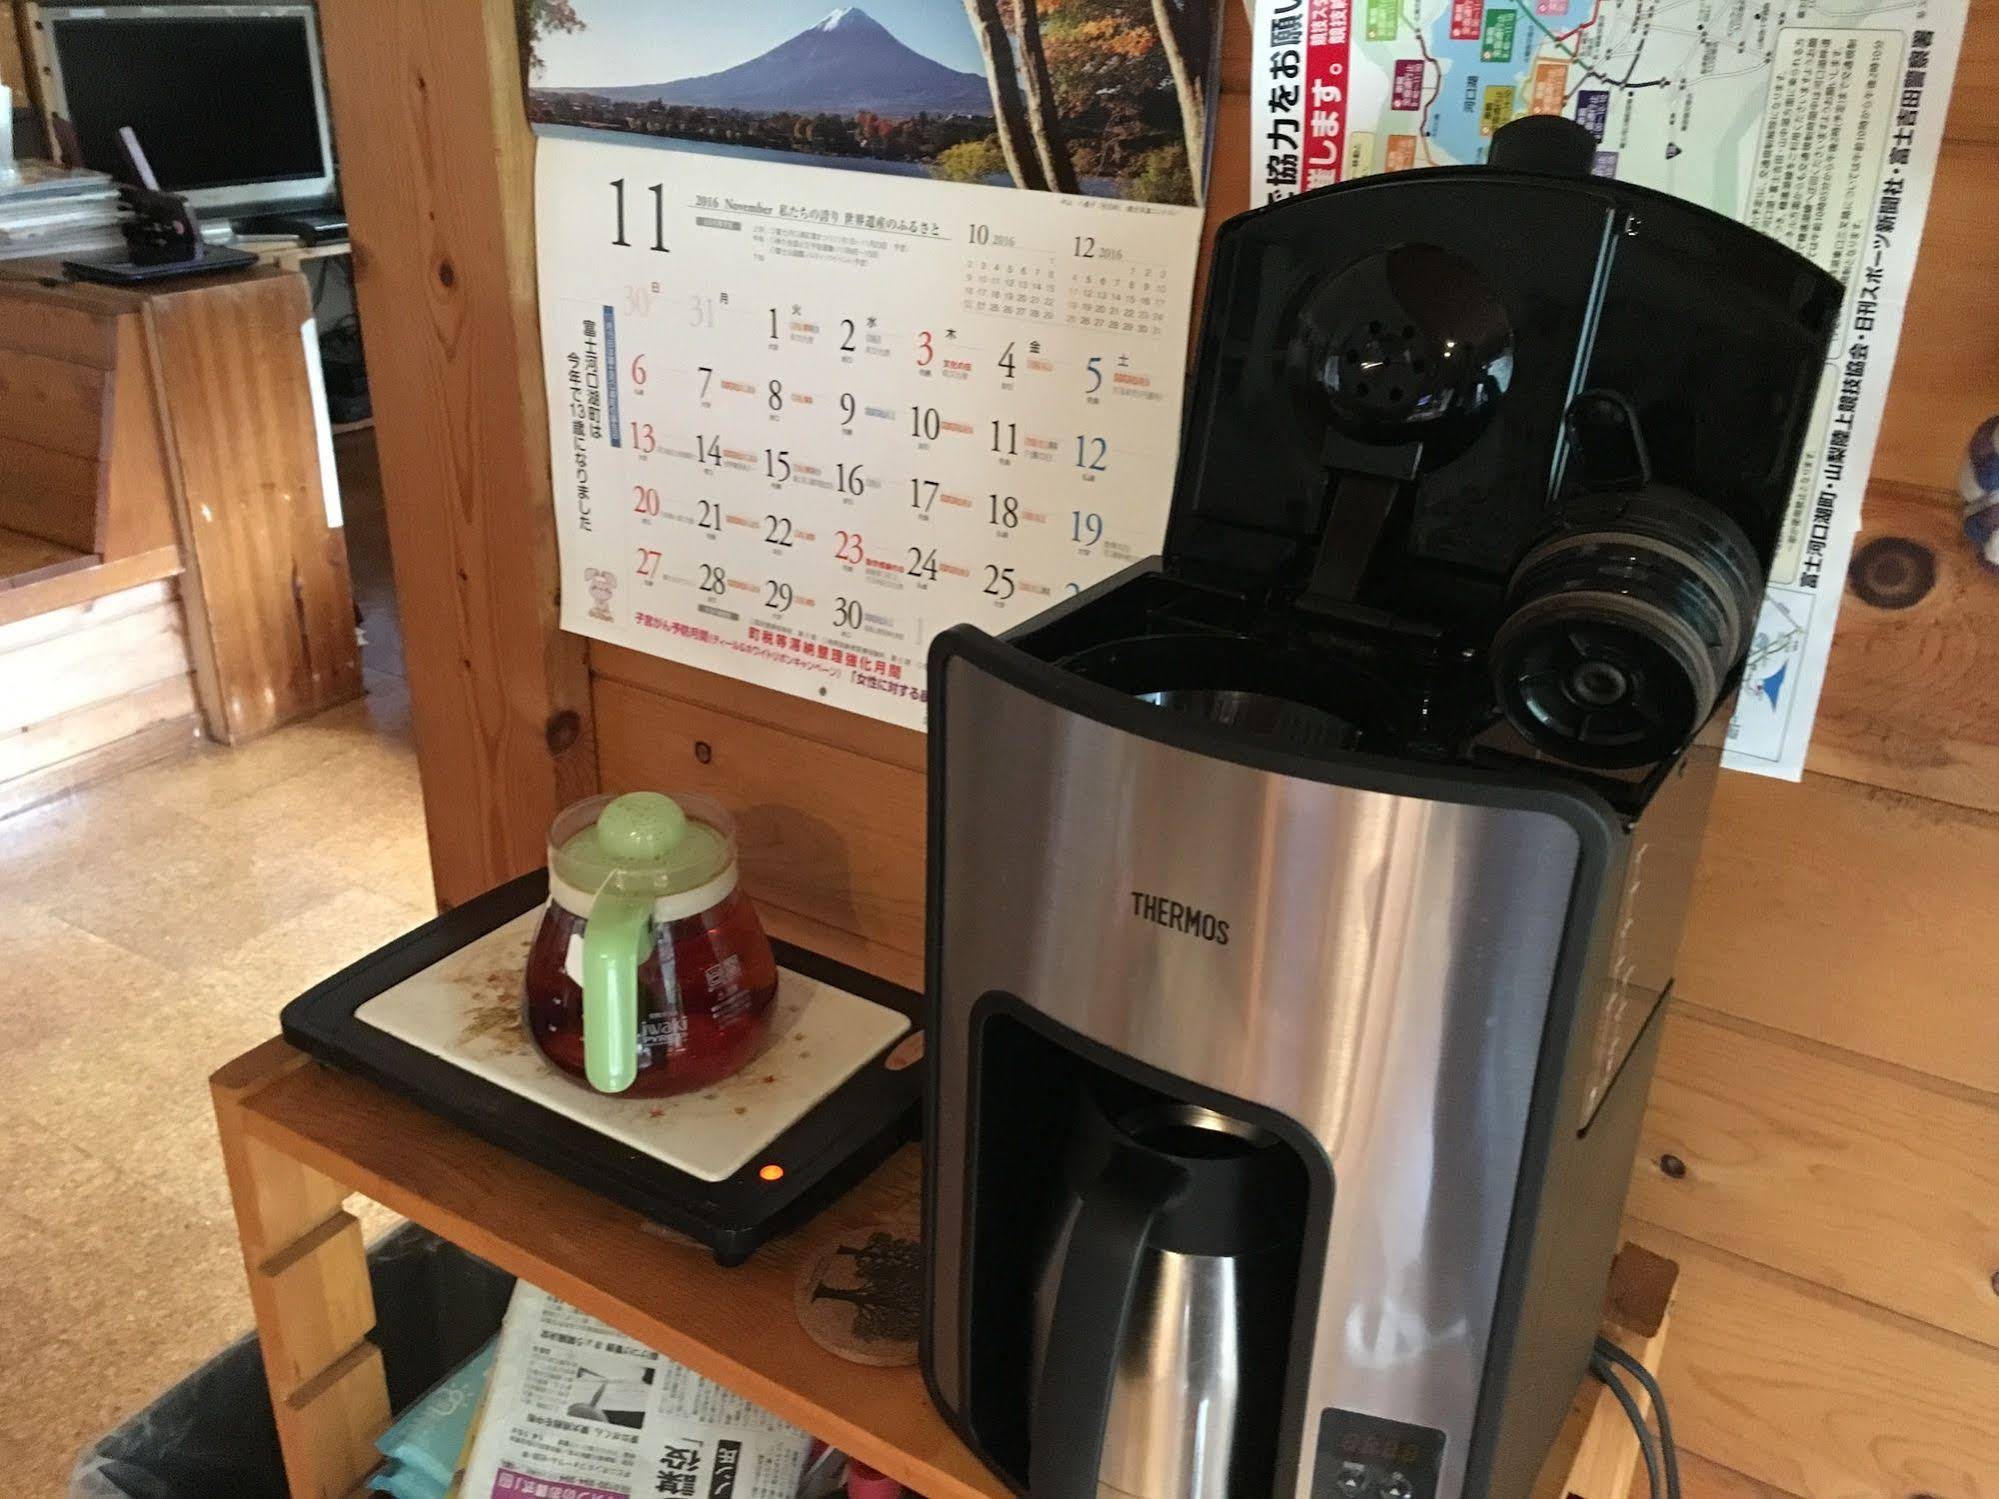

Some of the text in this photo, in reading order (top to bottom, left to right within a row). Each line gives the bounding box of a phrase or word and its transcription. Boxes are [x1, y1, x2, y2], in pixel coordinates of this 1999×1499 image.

[1463, 75, 1479, 113] 河口湖
[609, 178, 670, 253] 11
[696, 195, 719, 208] 2016
[725, 198, 773, 215] November
[968, 223, 989, 246] 10
[1074, 236, 1096, 258] 12
[769, 308, 779, 339] 1
[840, 319, 856, 351] 2
[916, 331, 933, 367] 3
[998, 342, 1016, 378] 4
[1085, 357, 1103, 394] 5
[945, 328, 956, 339] 木
[1029, 340, 1041, 354] 金
[1117, 354, 1129, 367] 土
[631, 354, 647, 385] 6
[698, 366, 713, 399] 7
[769, 380, 783, 411] 8
[840, 393, 856, 426] 9
[911, 405, 940, 440] 10
[991, 420, 1018, 455] 11
[1076, 435, 1107, 471] 12
[631, 421, 1103, 546] 13 14 15 16 17 18 19
[633, 485, 1015, 600] 20 21 22 23 24 25
[636, 548, 863, 630] 27 28 29 30
[1131, 891, 1230, 945] THERMOS
